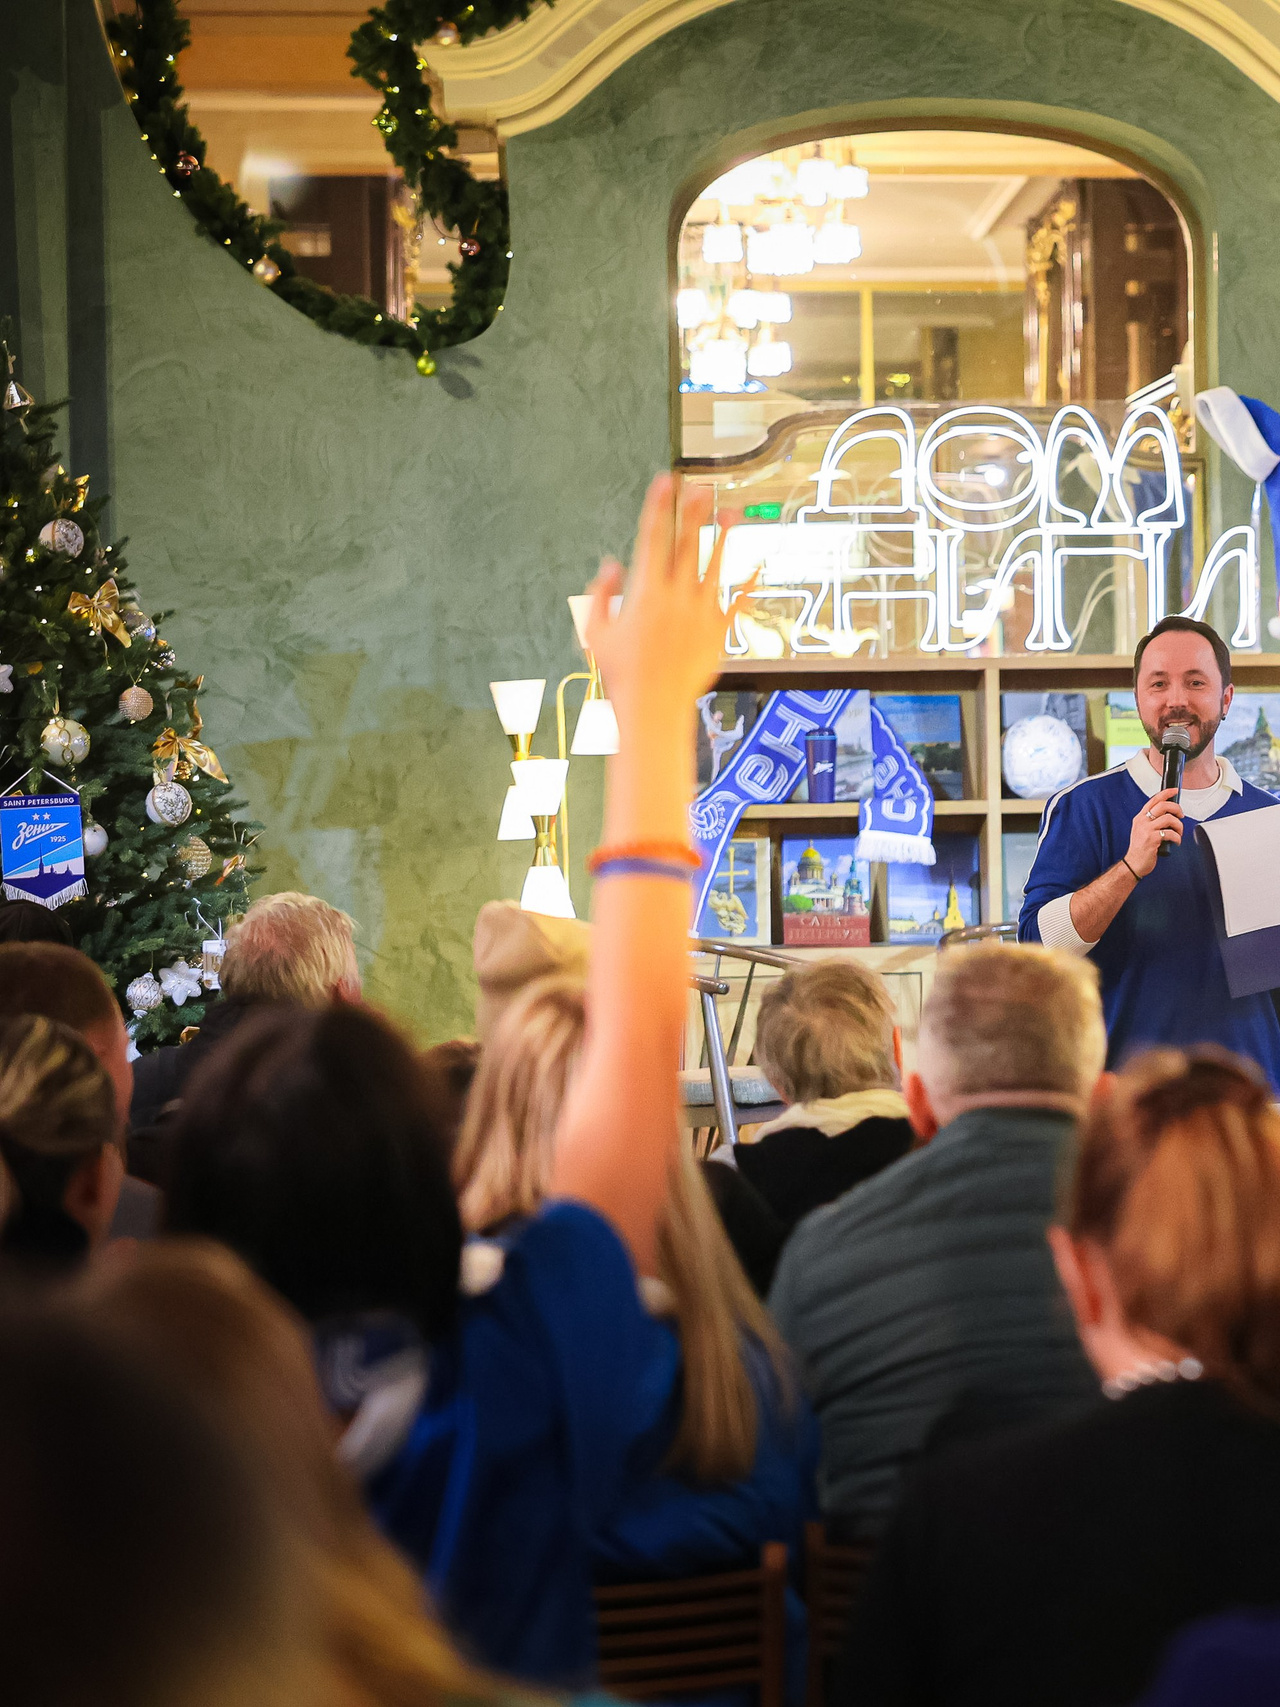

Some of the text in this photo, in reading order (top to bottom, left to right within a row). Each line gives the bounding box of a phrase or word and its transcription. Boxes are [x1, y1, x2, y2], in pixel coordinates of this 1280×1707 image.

[797, 405, 1186, 532] ДОМ
[27, 797, 75, 806] PETERSBURG
[50, 835, 67, 843] 1925
